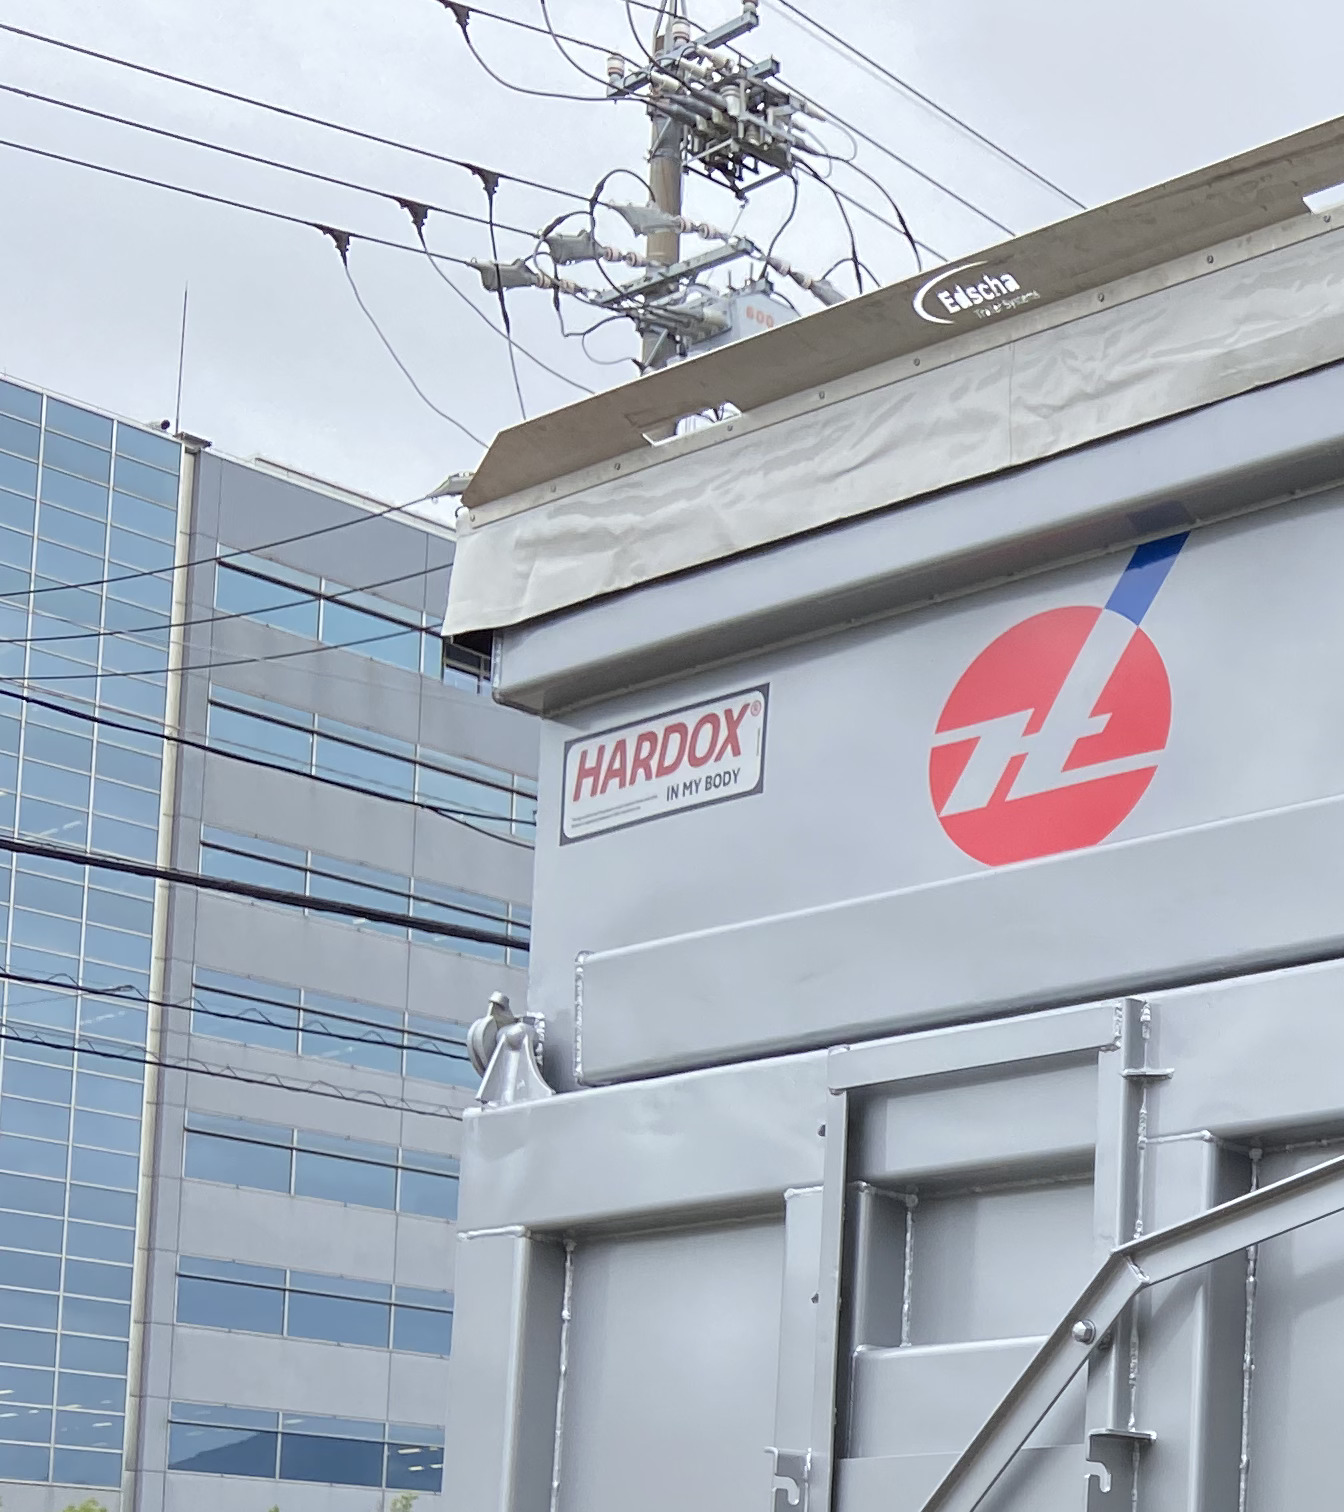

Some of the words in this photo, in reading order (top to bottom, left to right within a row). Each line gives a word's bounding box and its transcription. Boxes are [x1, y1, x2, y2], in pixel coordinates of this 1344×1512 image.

[937, 273, 1021, 314] Edscha
[572, 702, 751, 803] HARDOX
[666, 783, 680, 802] IN
[682, 776, 702, 798] MY
[704, 767, 741, 792] BODY
